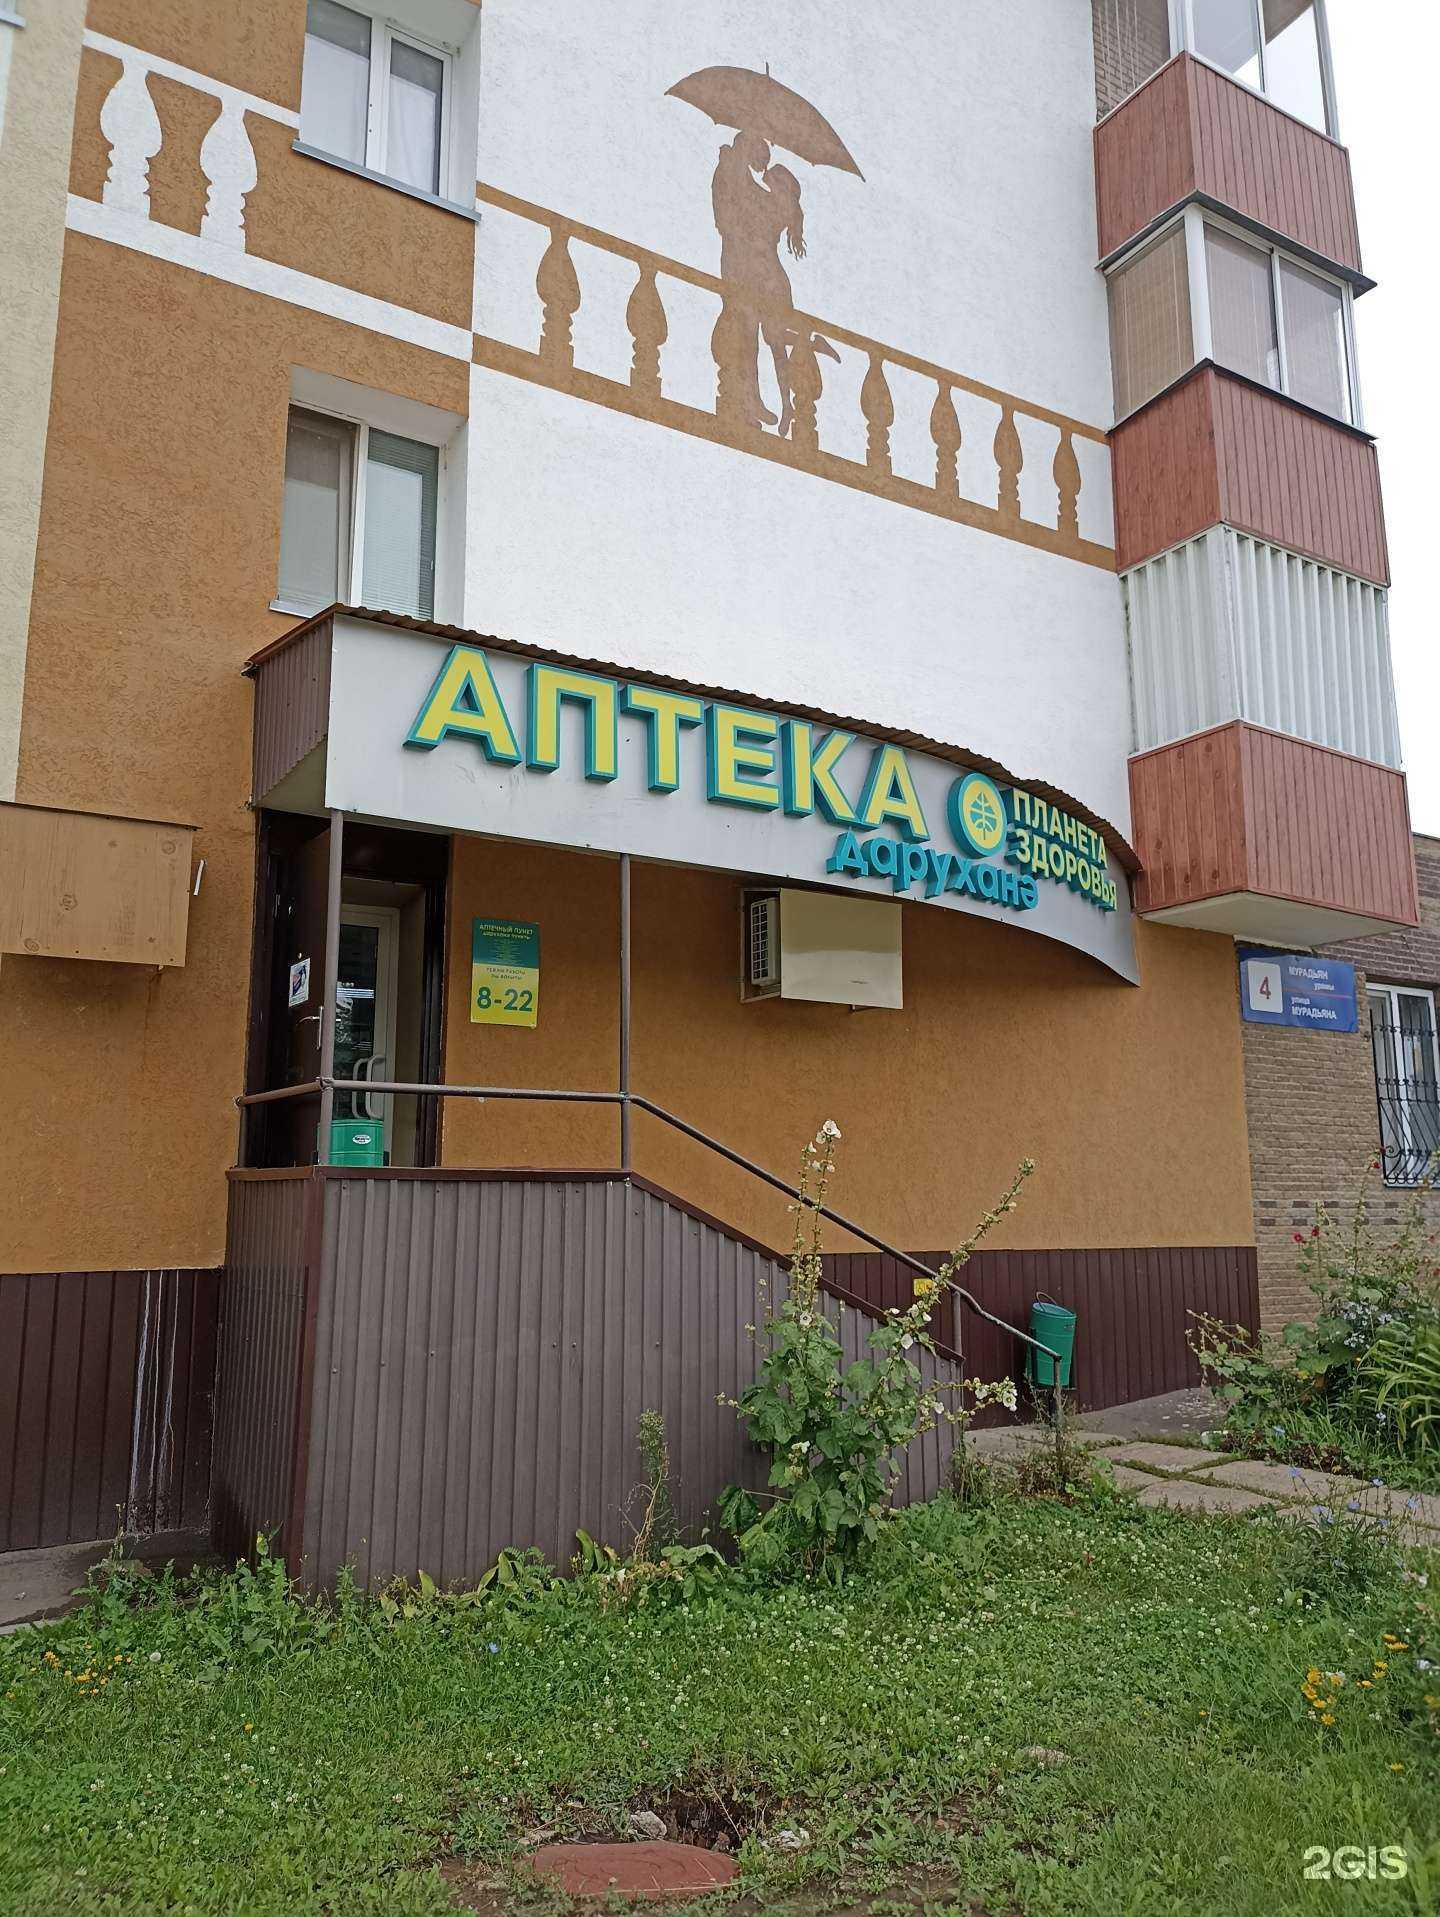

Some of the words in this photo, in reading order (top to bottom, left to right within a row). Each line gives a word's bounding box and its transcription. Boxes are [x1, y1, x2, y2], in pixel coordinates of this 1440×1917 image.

[403, 644, 930, 844] АПТЕКА
[1003, 787, 1107, 870] ПЛАНЕТА
[1007, 828, 1118, 912] ЗДОРОВЬЯ
[479, 924, 513, 934] АПТЕЧНЫЙ
[1288, 966, 1329, 980] МУРАДЬЯН
[477, 986, 533, 1012] 8-22
[1259, 976, 1271, 1000] 4
[1291, 1006, 1337, 1020] МУРАДЬЯНА
